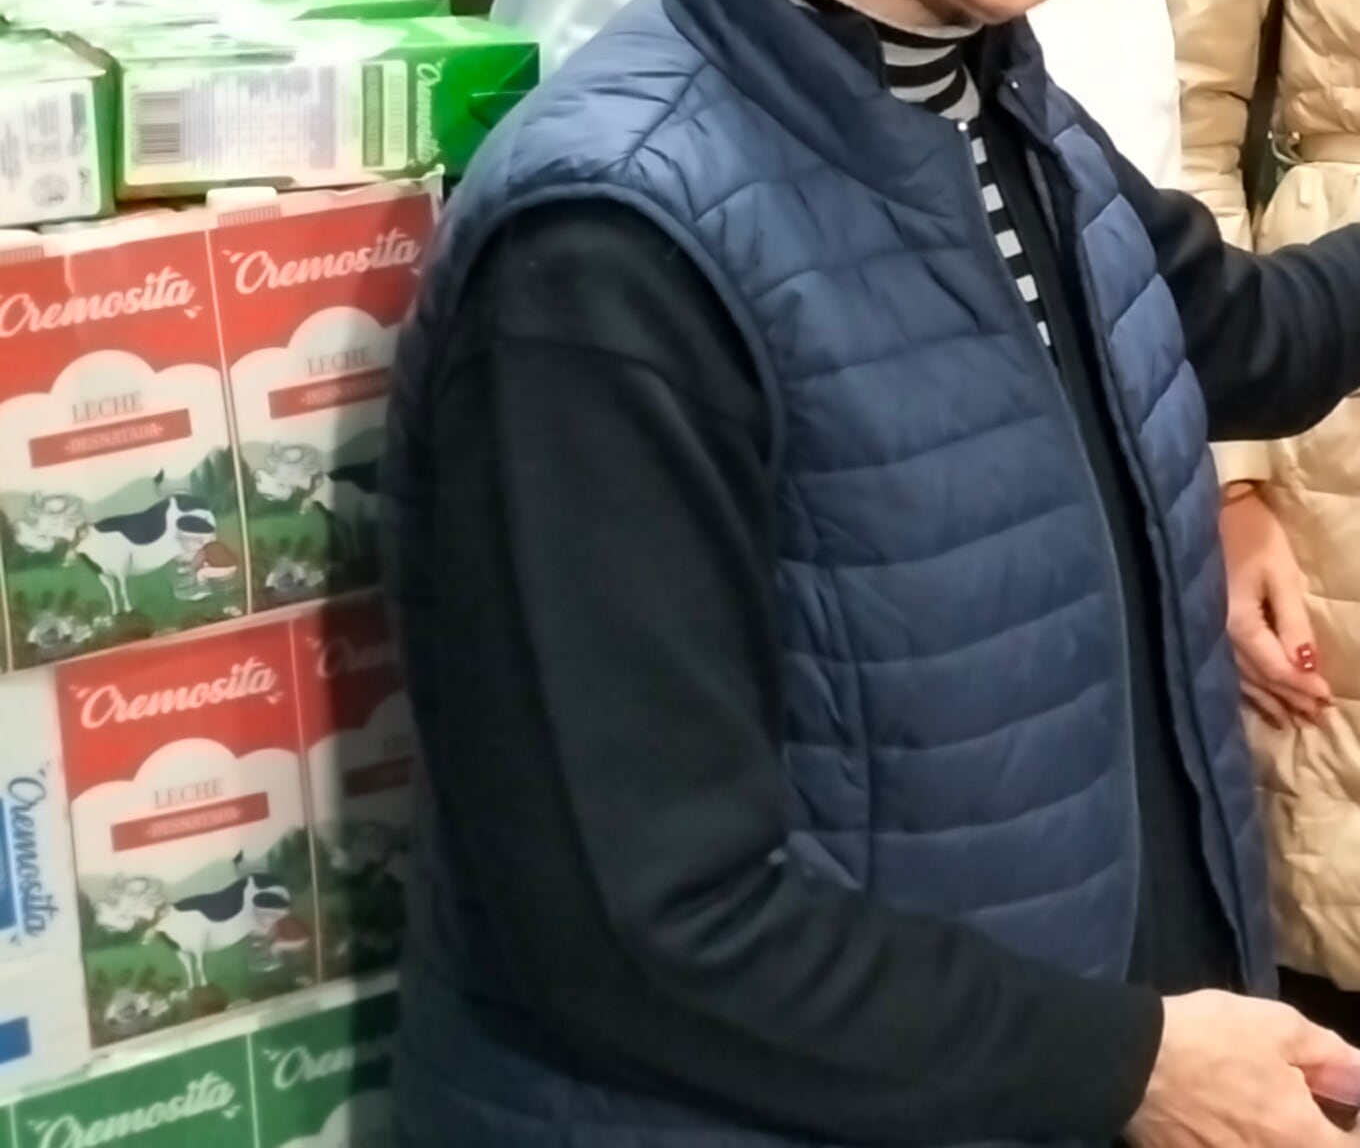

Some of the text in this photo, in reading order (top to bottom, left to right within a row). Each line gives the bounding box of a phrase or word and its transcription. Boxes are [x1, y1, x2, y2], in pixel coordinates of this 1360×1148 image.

[234, 227, 421, 295] Cremosita
[0, 265, 195, 338] Cremosita
[307, 347, 371, 376] LECHE
[72, 391, 143, 424] LECHE
[80, 656, 276, 730] Cremosita
[153, 777, 224, 809] LECHE
[7, 776, 59, 937] Cremosita
[39, 1070, 235, 1148] Cremosita
